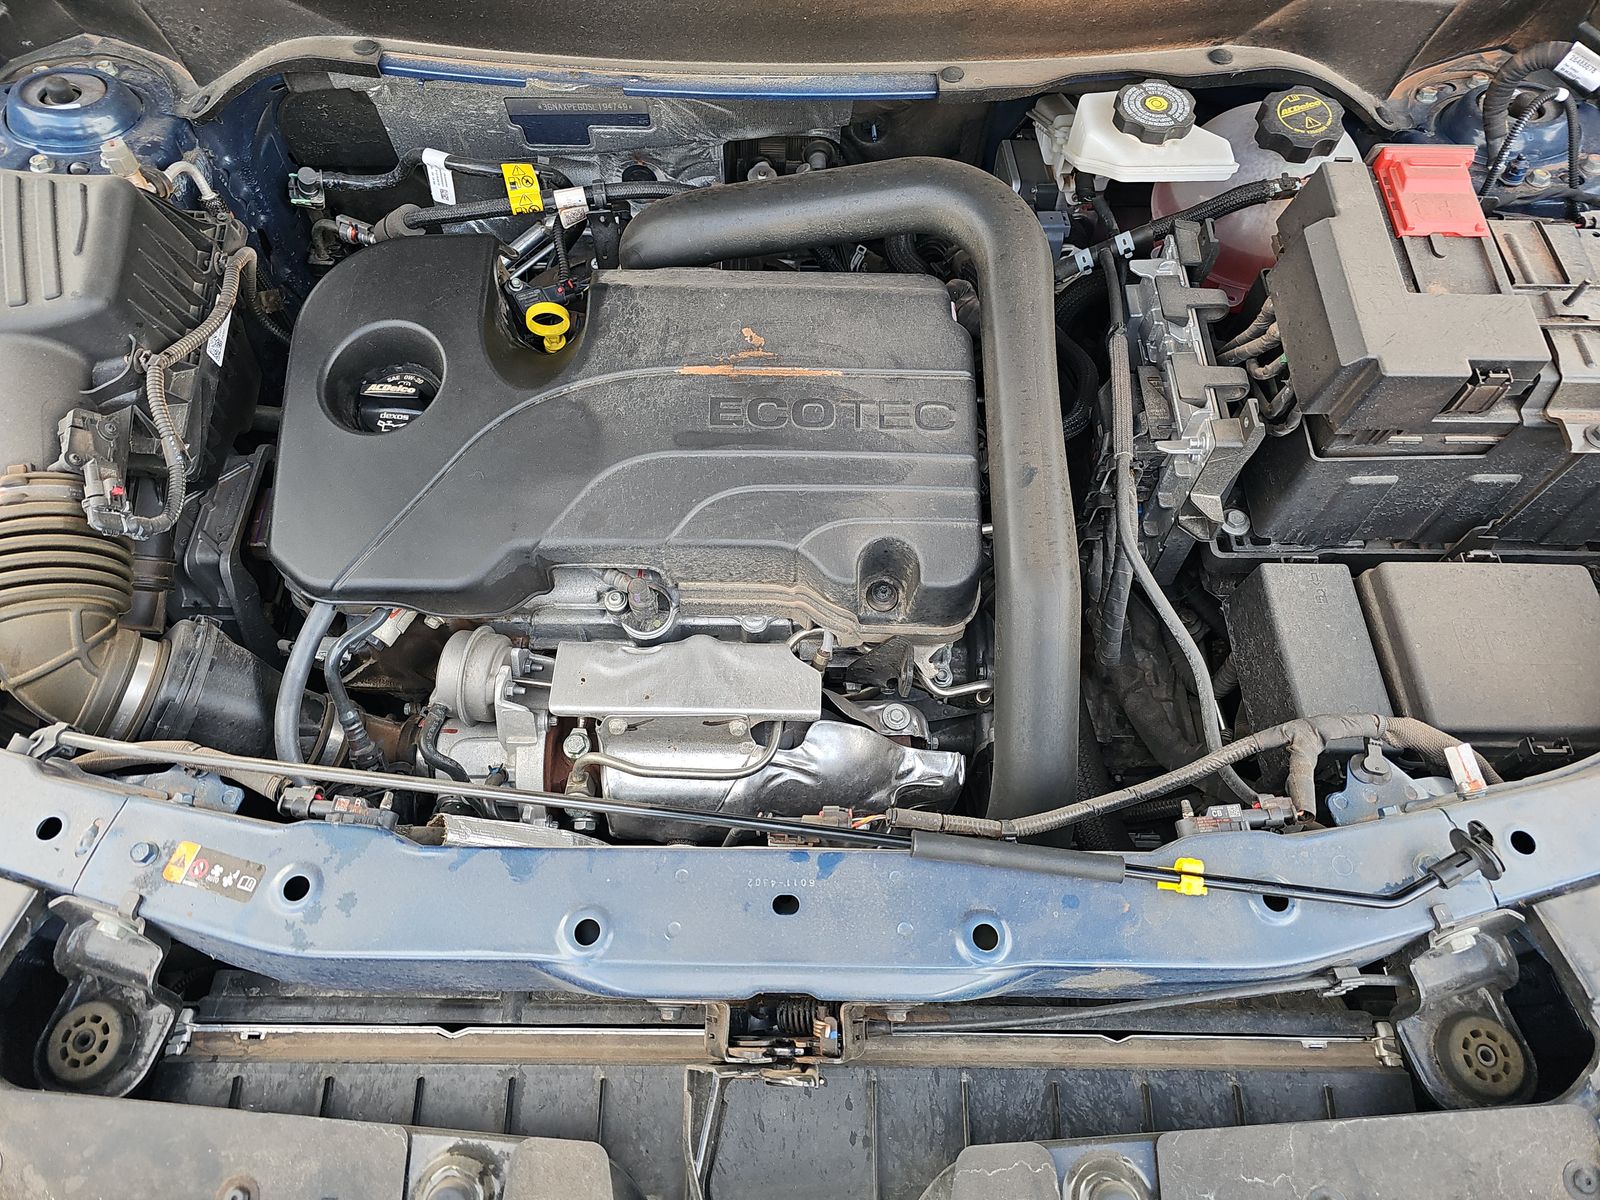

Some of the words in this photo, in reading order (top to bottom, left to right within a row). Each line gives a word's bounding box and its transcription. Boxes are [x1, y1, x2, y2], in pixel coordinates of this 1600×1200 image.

[1281, 100, 1322, 116] ACDelco
[386, 375, 400, 383] SAE
[366, 383, 416, 393] ACDelco
[379, 411, 410, 421] dexos
[708, 395, 957, 431] ECOTEC
